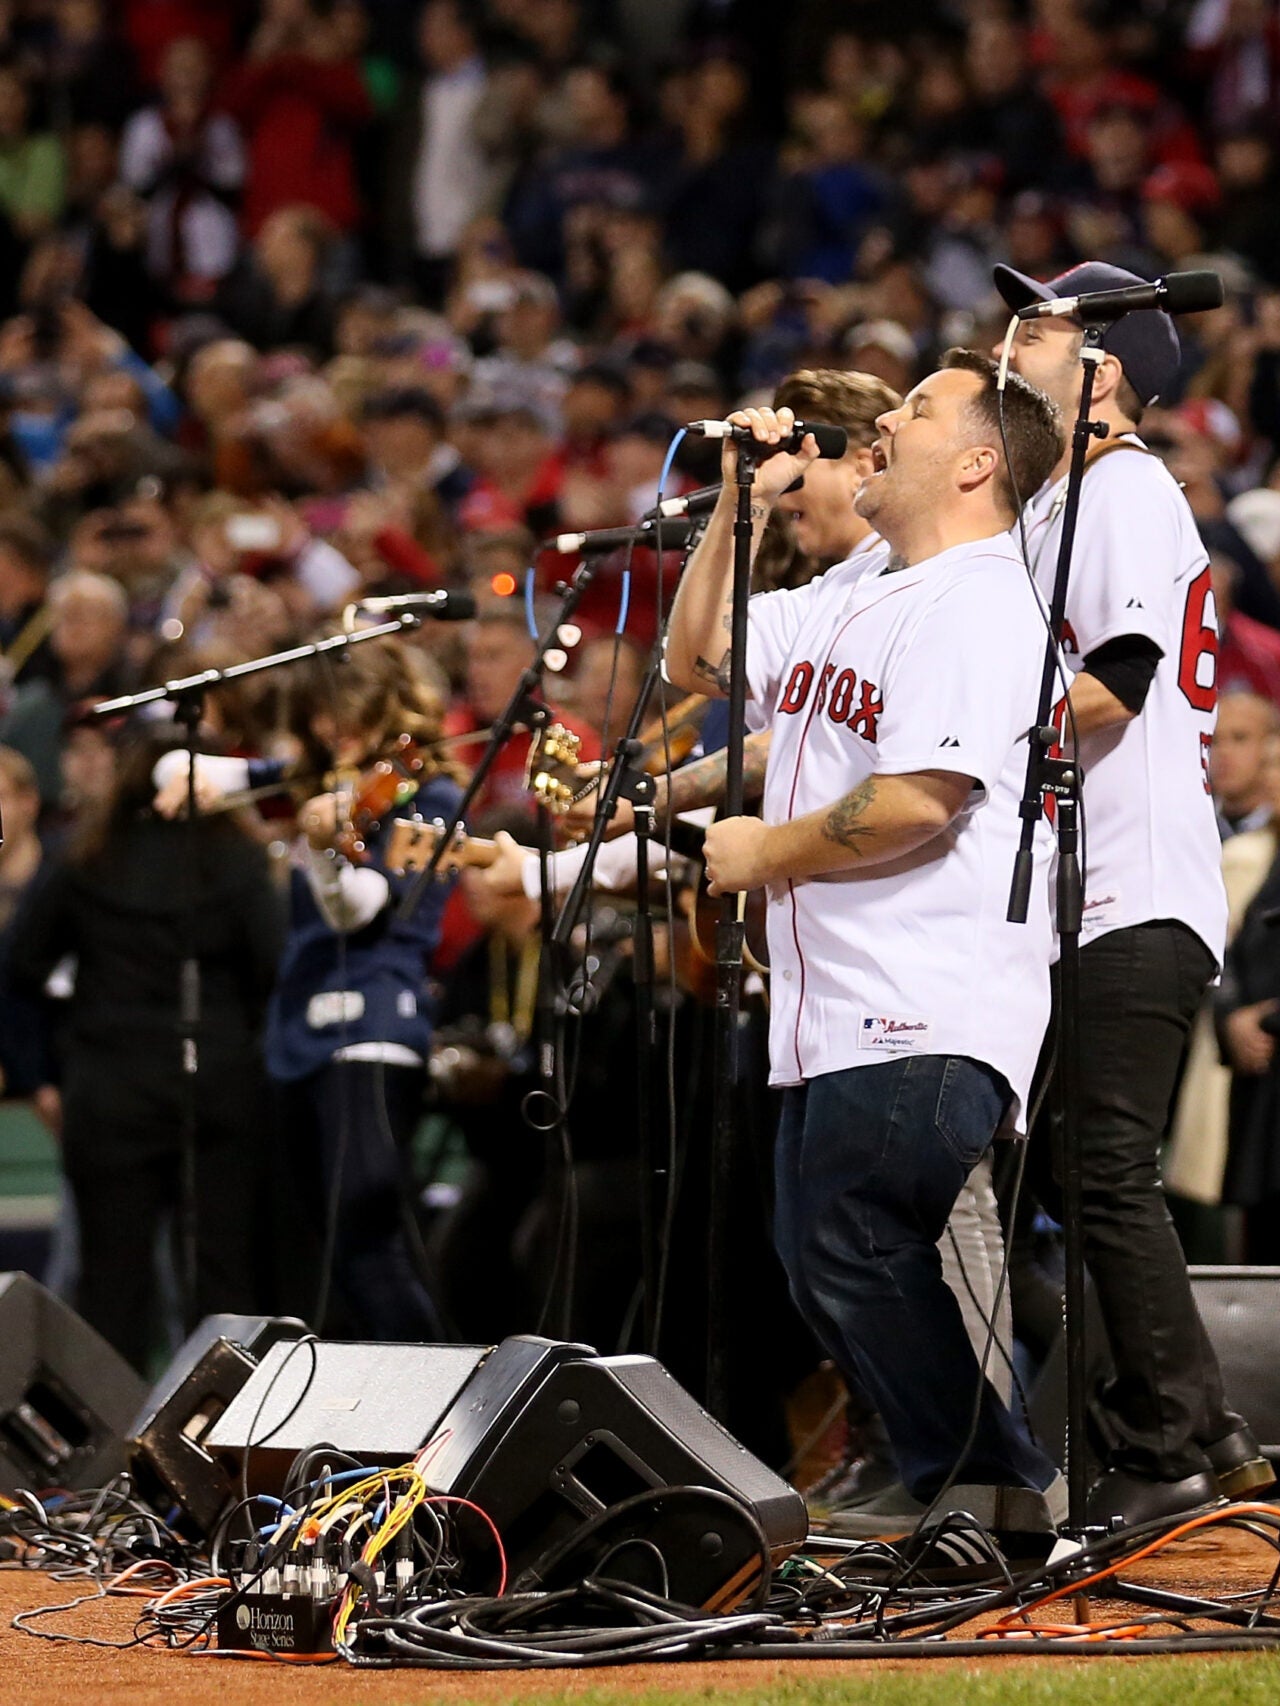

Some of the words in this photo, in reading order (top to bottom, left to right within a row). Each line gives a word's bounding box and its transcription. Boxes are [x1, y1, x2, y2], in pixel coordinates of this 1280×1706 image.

[884, 1020, 927, 1033] Authentic
[250, 1607, 294, 1631] Horizon
[272, 1631, 295, 1647] Series
